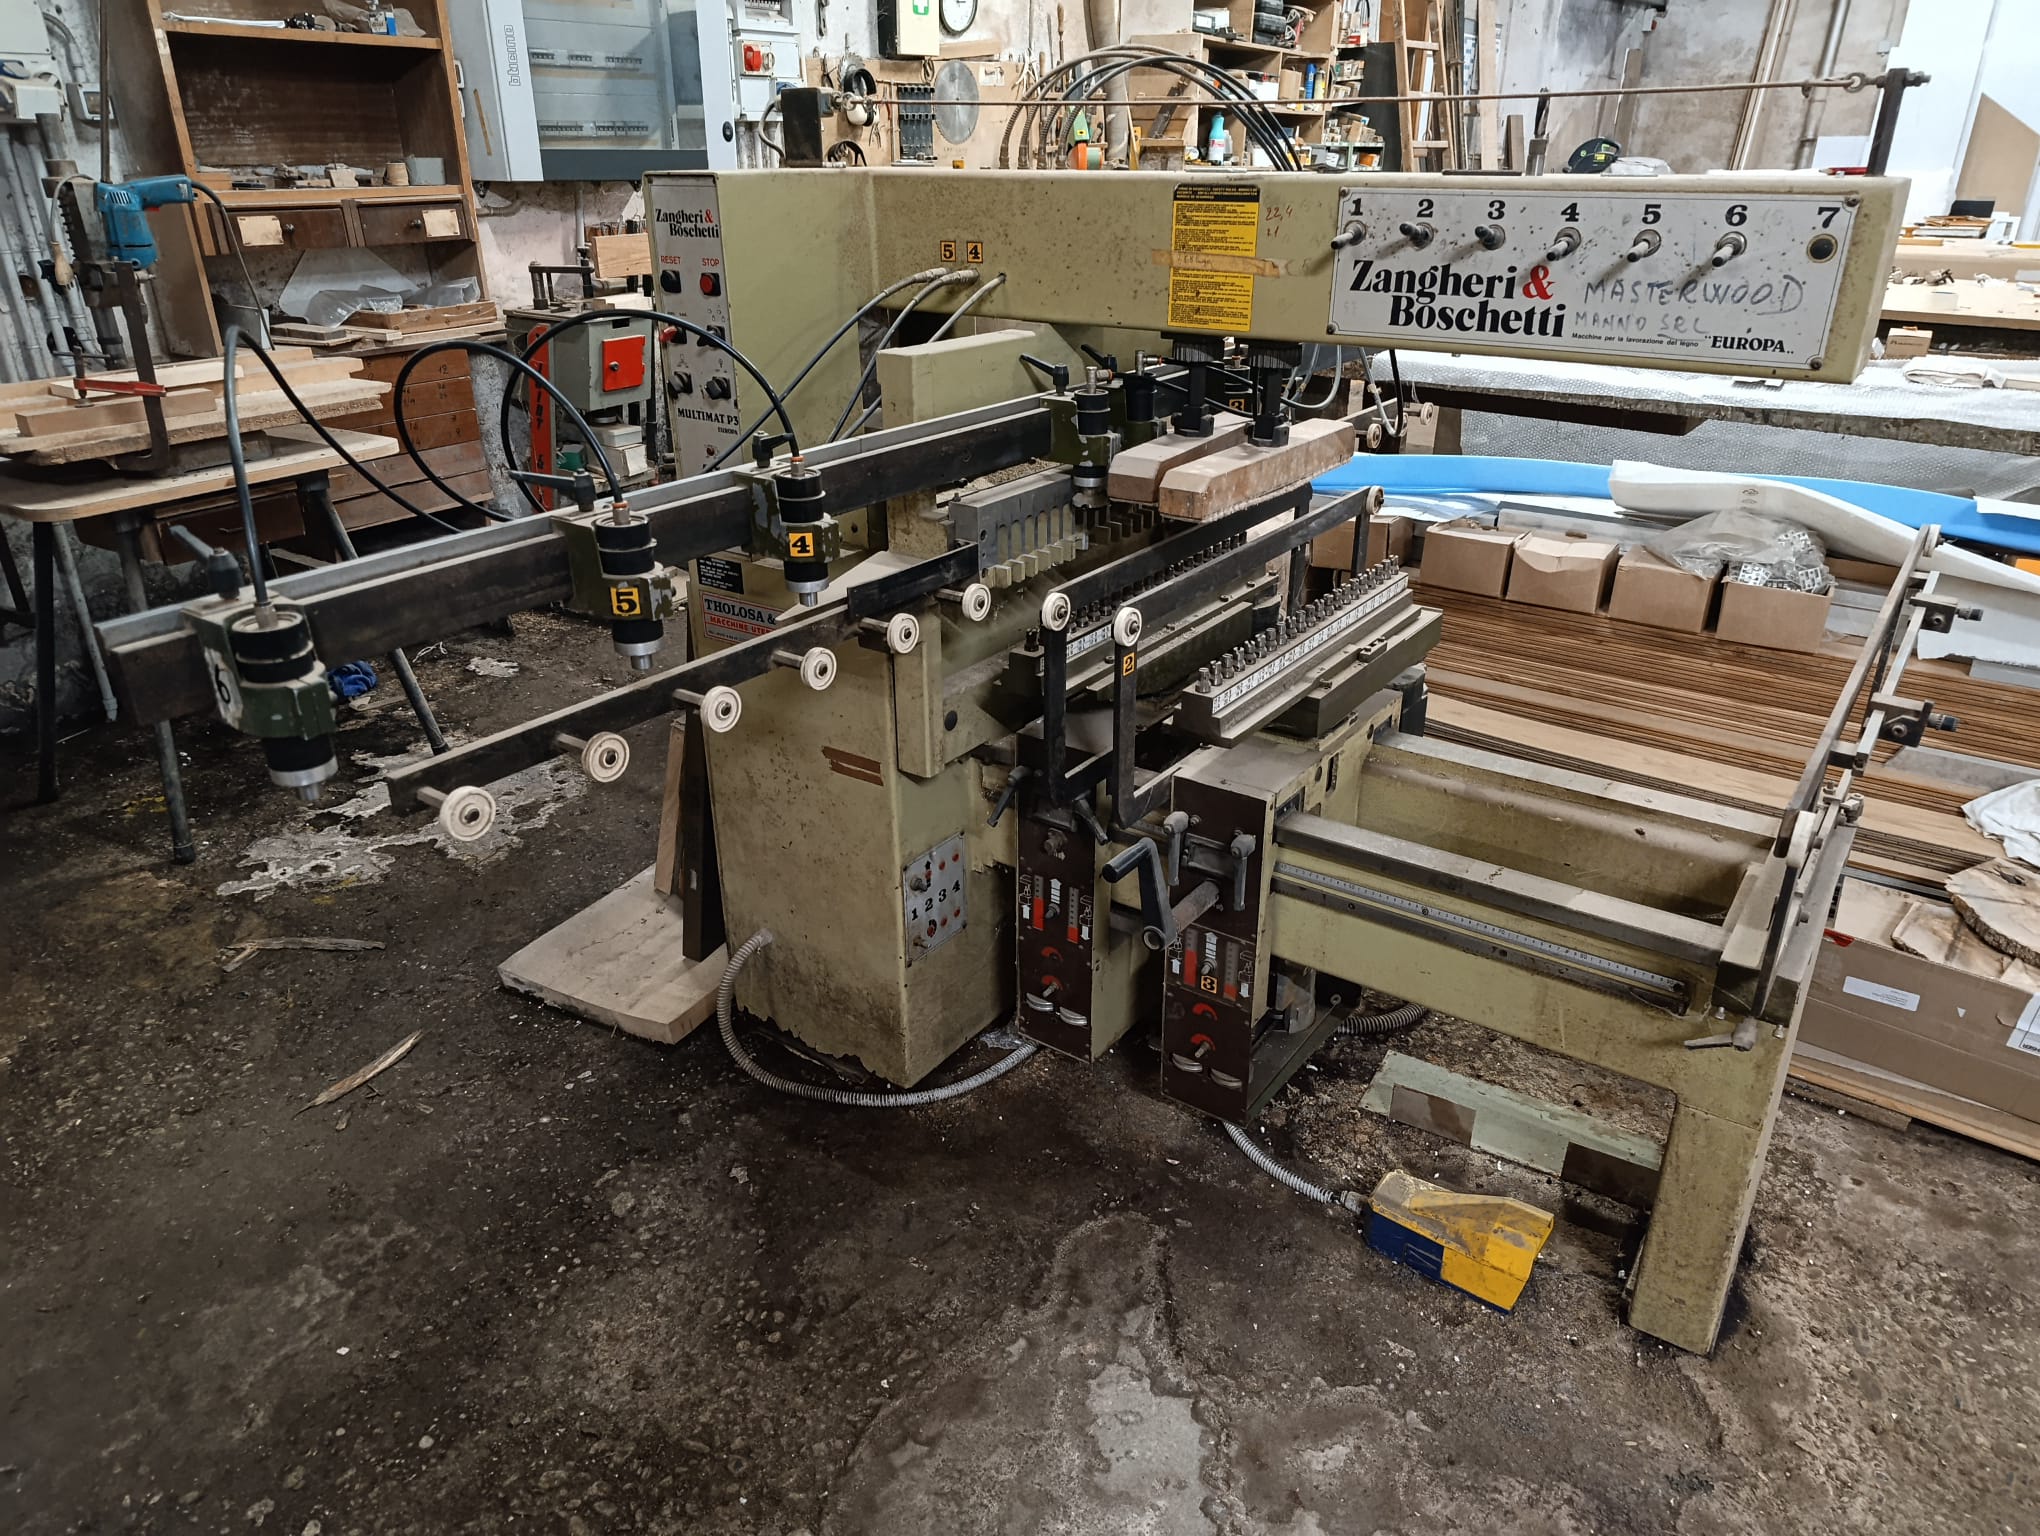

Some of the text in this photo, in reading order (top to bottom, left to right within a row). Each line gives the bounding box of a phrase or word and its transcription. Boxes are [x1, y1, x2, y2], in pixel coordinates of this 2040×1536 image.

[656, 208, 714, 226] Zangheri &
[1350, 197, 1841, 229] 1 2 3 4 5 6 7
[669, 223, 720, 239] Boschetti
[660, 255, 720, 267] RESET STOP
[943, 243, 981, 260] 5 4
[1349, 259, 1557, 305] Zangheri &
[1584, 274, 1806, 315] MASTERWOOD
[1388, 295, 1567, 338] Boschetti
[1574, 311, 1710, 335] MANNO SRL
[1571, 332, 1602, 341] Macchine
[1625, 336, 1664, 345] lavorazione
[1666, 338, 1678, 346] del
[1679, 340, 1699, 348] legno
[677, 407, 739, 426] MULTIMAT P3
[791, 535, 811, 554] 4
[616, 591, 638, 614] 5
[704, 598, 776, 625] THOLOSA &
[710, 616, 749, 632] MACCHINE
[1124, 655, 1133, 674] 2
[214, 663, 231, 704] 6
[911, 880, 961, 921] 1 2 3 4
[1202, 976, 1216, 991] 3
